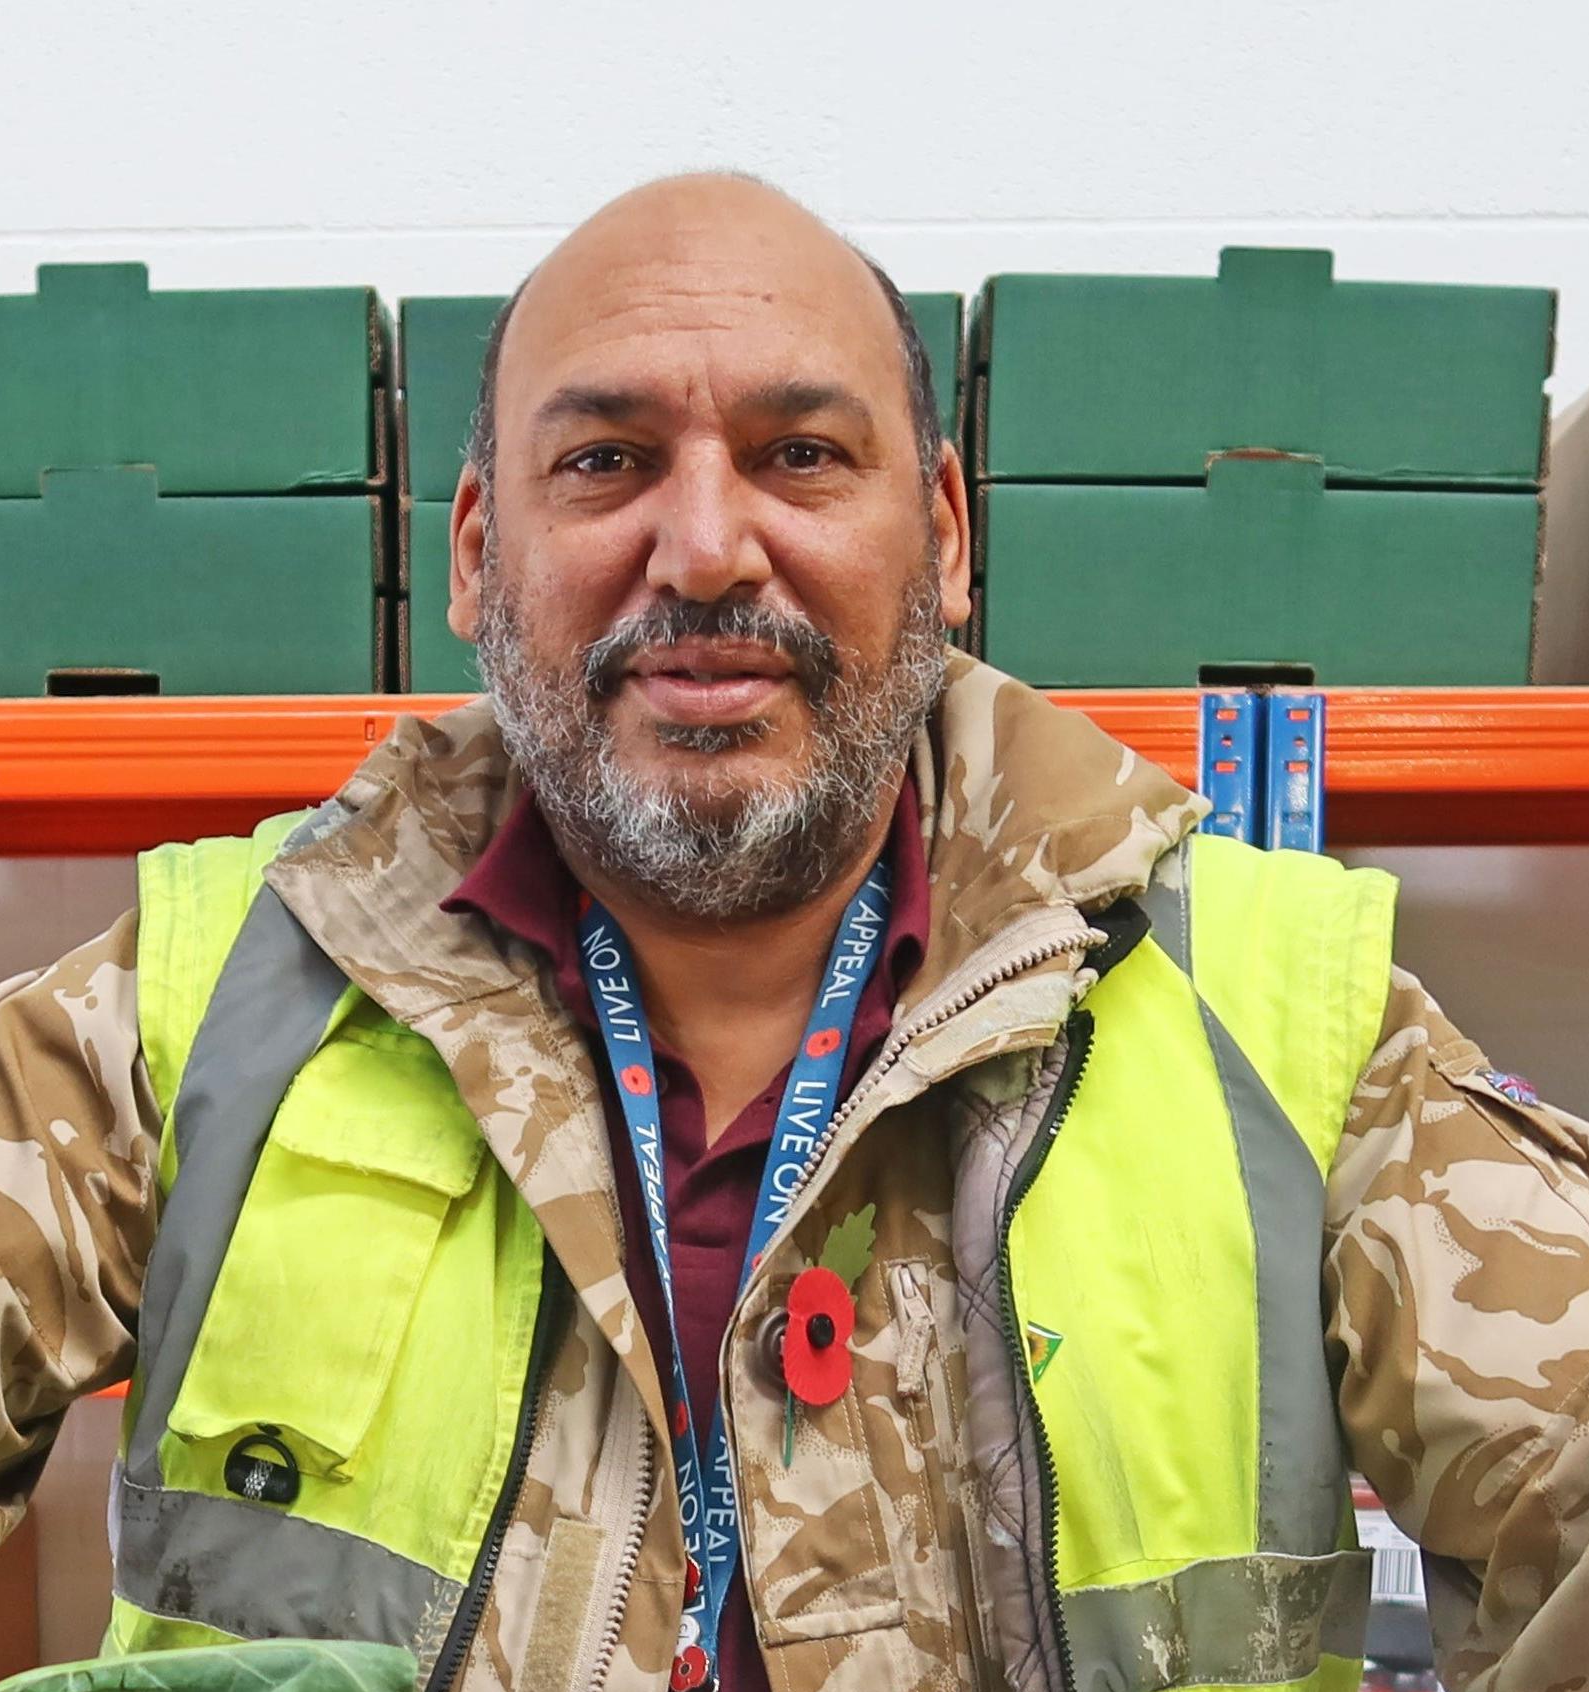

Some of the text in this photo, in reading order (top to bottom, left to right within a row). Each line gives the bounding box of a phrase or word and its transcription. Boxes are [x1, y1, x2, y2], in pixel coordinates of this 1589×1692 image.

[582, 925, 641, 1042] LIVE ON
[822, 899, 885, 1009] APPEAL
[780, 1080, 827, 1153] LIVE
[636, 1123, 668, 1254] APPEAL
